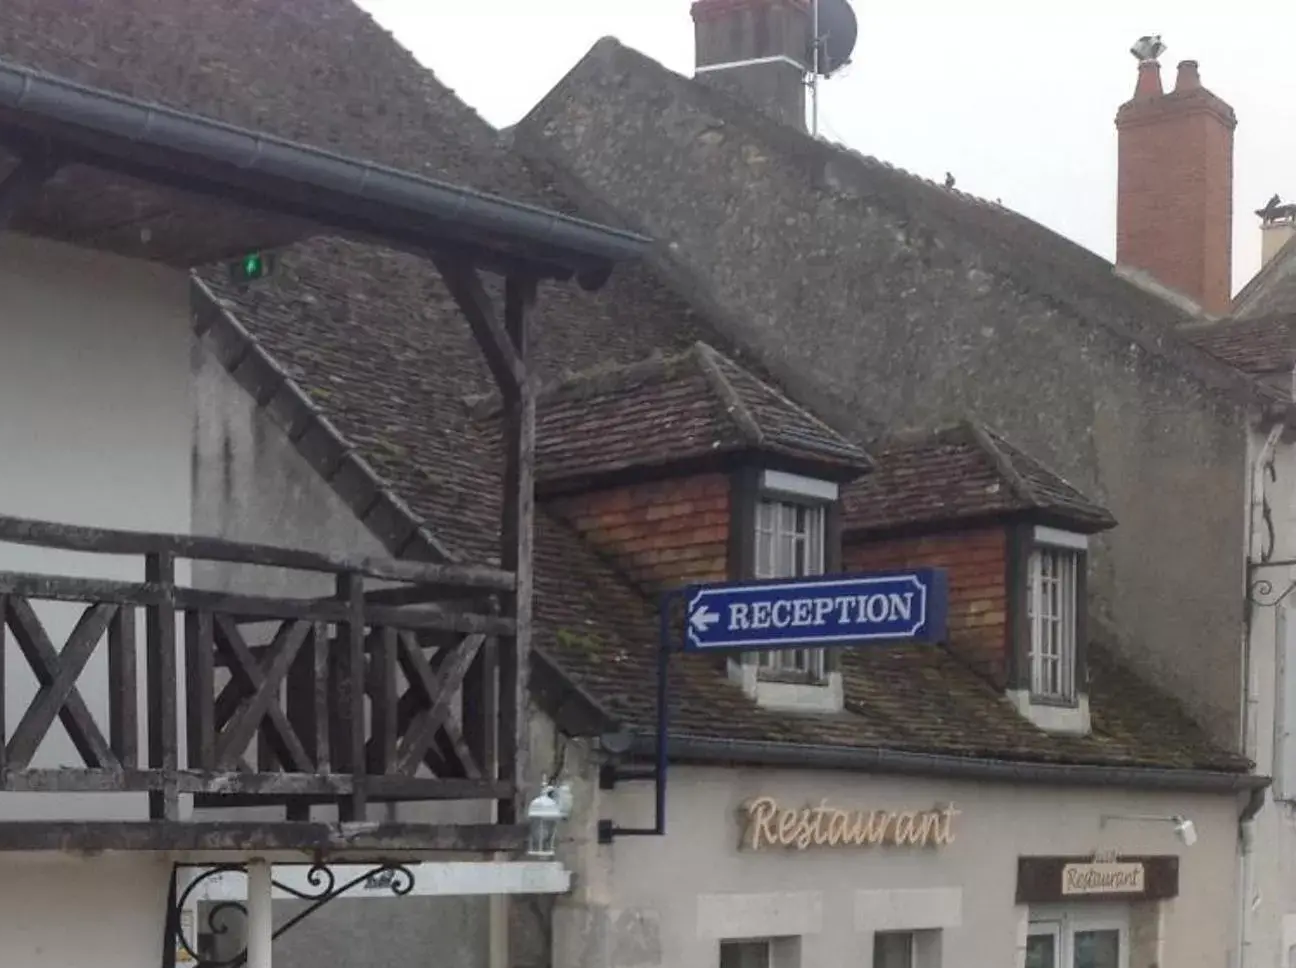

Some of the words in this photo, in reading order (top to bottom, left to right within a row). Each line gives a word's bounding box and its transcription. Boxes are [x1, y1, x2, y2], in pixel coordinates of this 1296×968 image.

[727, 592, 914, 631] RECEPTION
[750, 796, 962, 851] Restaurant
[1066, 866, 1141, 891] Restaurant
